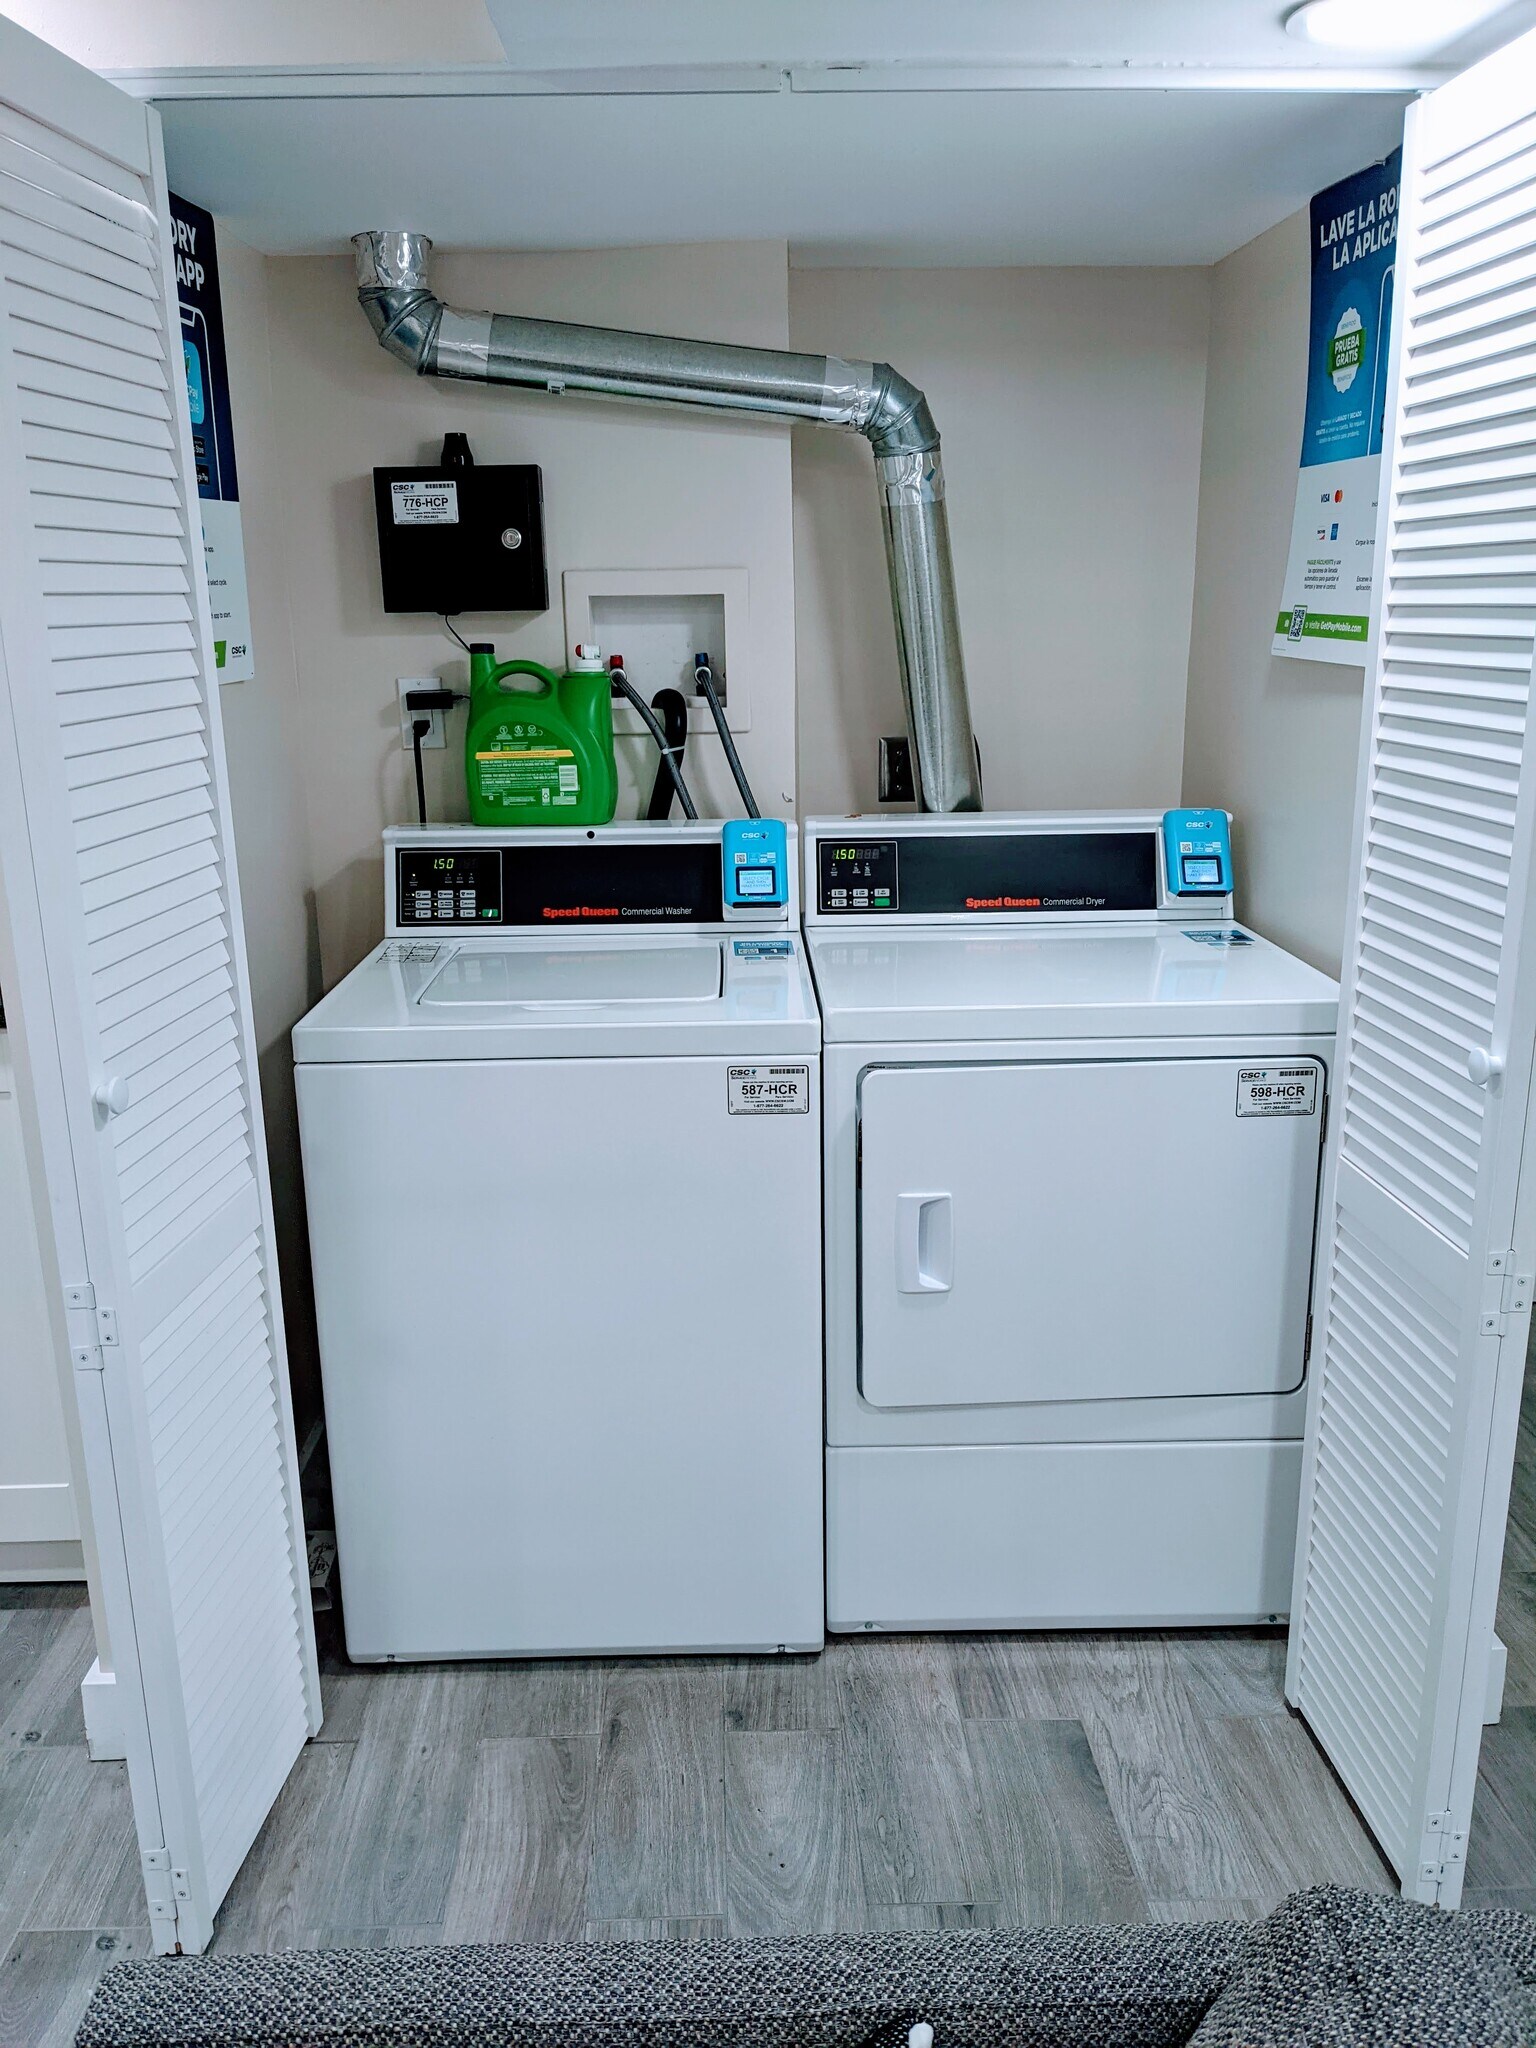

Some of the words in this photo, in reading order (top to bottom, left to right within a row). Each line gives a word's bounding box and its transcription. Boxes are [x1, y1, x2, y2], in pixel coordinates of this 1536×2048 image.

[1320, 209, 1356, 249] LAVE
[1358, 200, 1376, 231] LA
[1332, 242, 1350, 271] LA
[176, 254, 205, 291] APP
[1334, 334, 1360, 355] PRUEBA
[1335, 347, 1359, 367] GRATIS
[402, 497, 449, 508] 776-HCP
[1320, 621, 1362, 633] GetPayMobile.com
[231, 646, 242, 655] CSC
[966, 897, 1002, 908] Speed
[1003, 896, 1040, 907] Queen
[1043, 897, 1084, 906] Commercial
[1085, 897, 1106, 907] Dryer
[543, 907, 580, 918] Speed
[581, 906, 619, 916] Queen
[621, 907, 664, 916] Commercial
[665, 906, 693, 915] Washer
[741, 1084, 798, 1095] 587-HCR
[1250, 1086, 1306, 1098] 598-HCR
